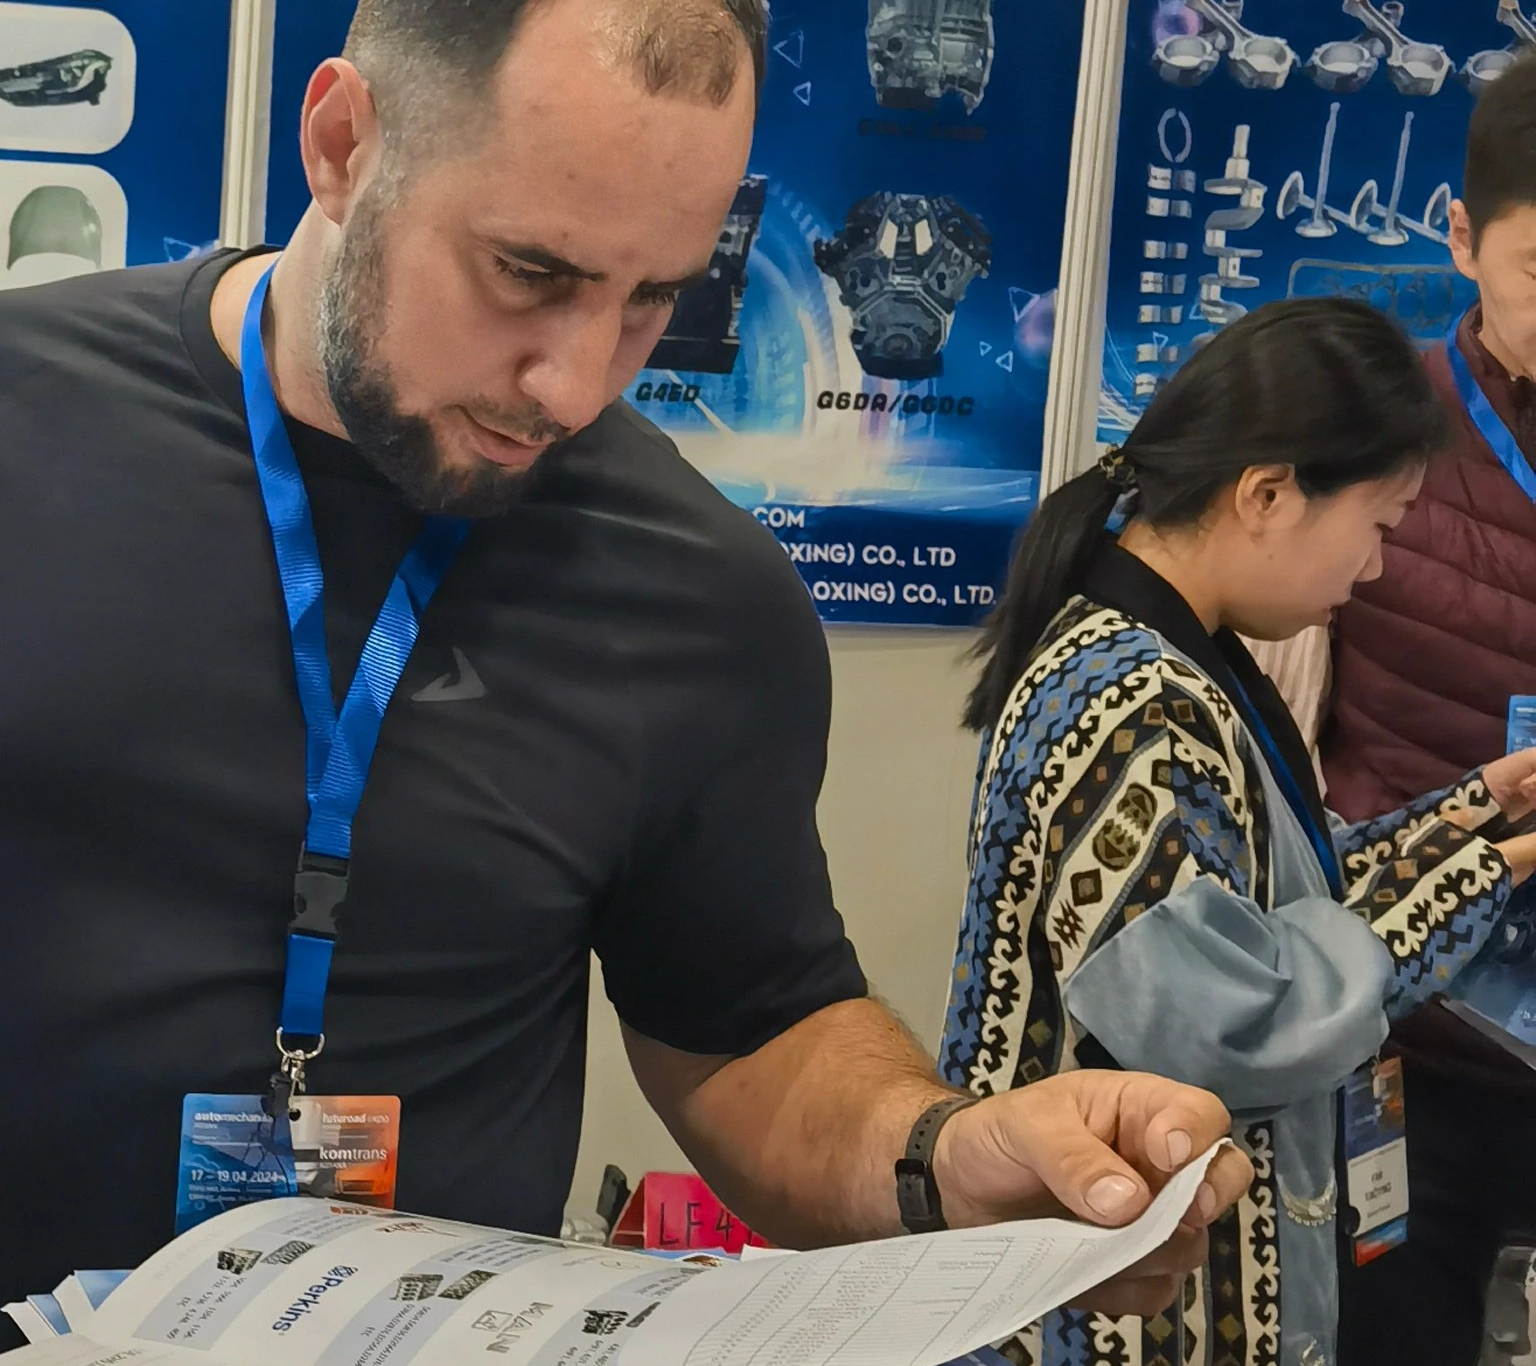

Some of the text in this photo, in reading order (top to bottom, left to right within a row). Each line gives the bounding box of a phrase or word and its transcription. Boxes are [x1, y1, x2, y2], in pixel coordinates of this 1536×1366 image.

[635, 382, 700, 404] G4ED
[914, 547, 956, 567] LTD
[319, 1146, 388, 1160] komtrans
[272, 1273, 341, 1333] Perkins
